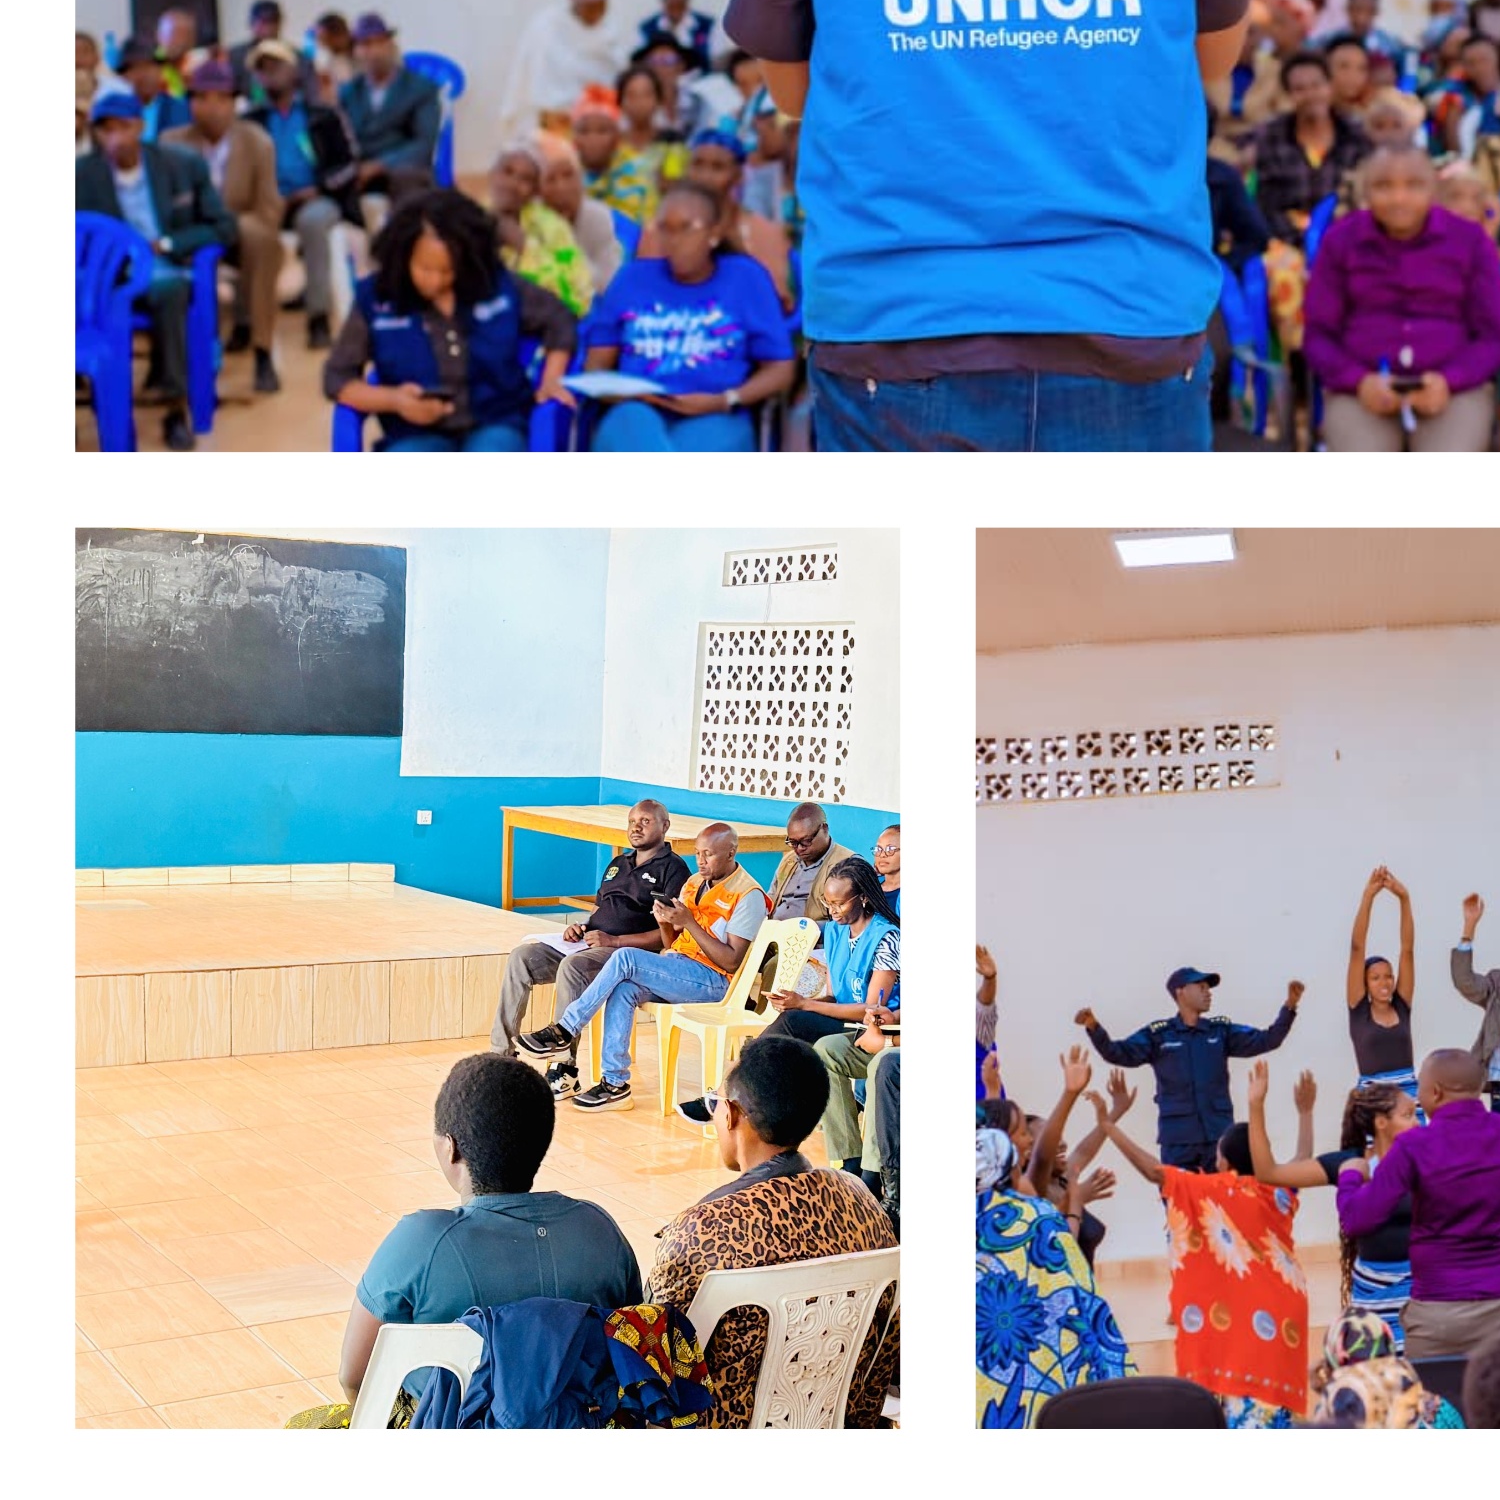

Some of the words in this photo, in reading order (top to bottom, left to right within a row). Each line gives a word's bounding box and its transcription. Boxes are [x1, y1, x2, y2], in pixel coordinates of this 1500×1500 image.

[888, 31, 928, 52] The
[931, 29, 964, 50] UN
[969, 27, 1058, 50] Refugee
[1063, 25, 1142, 48] Agency
